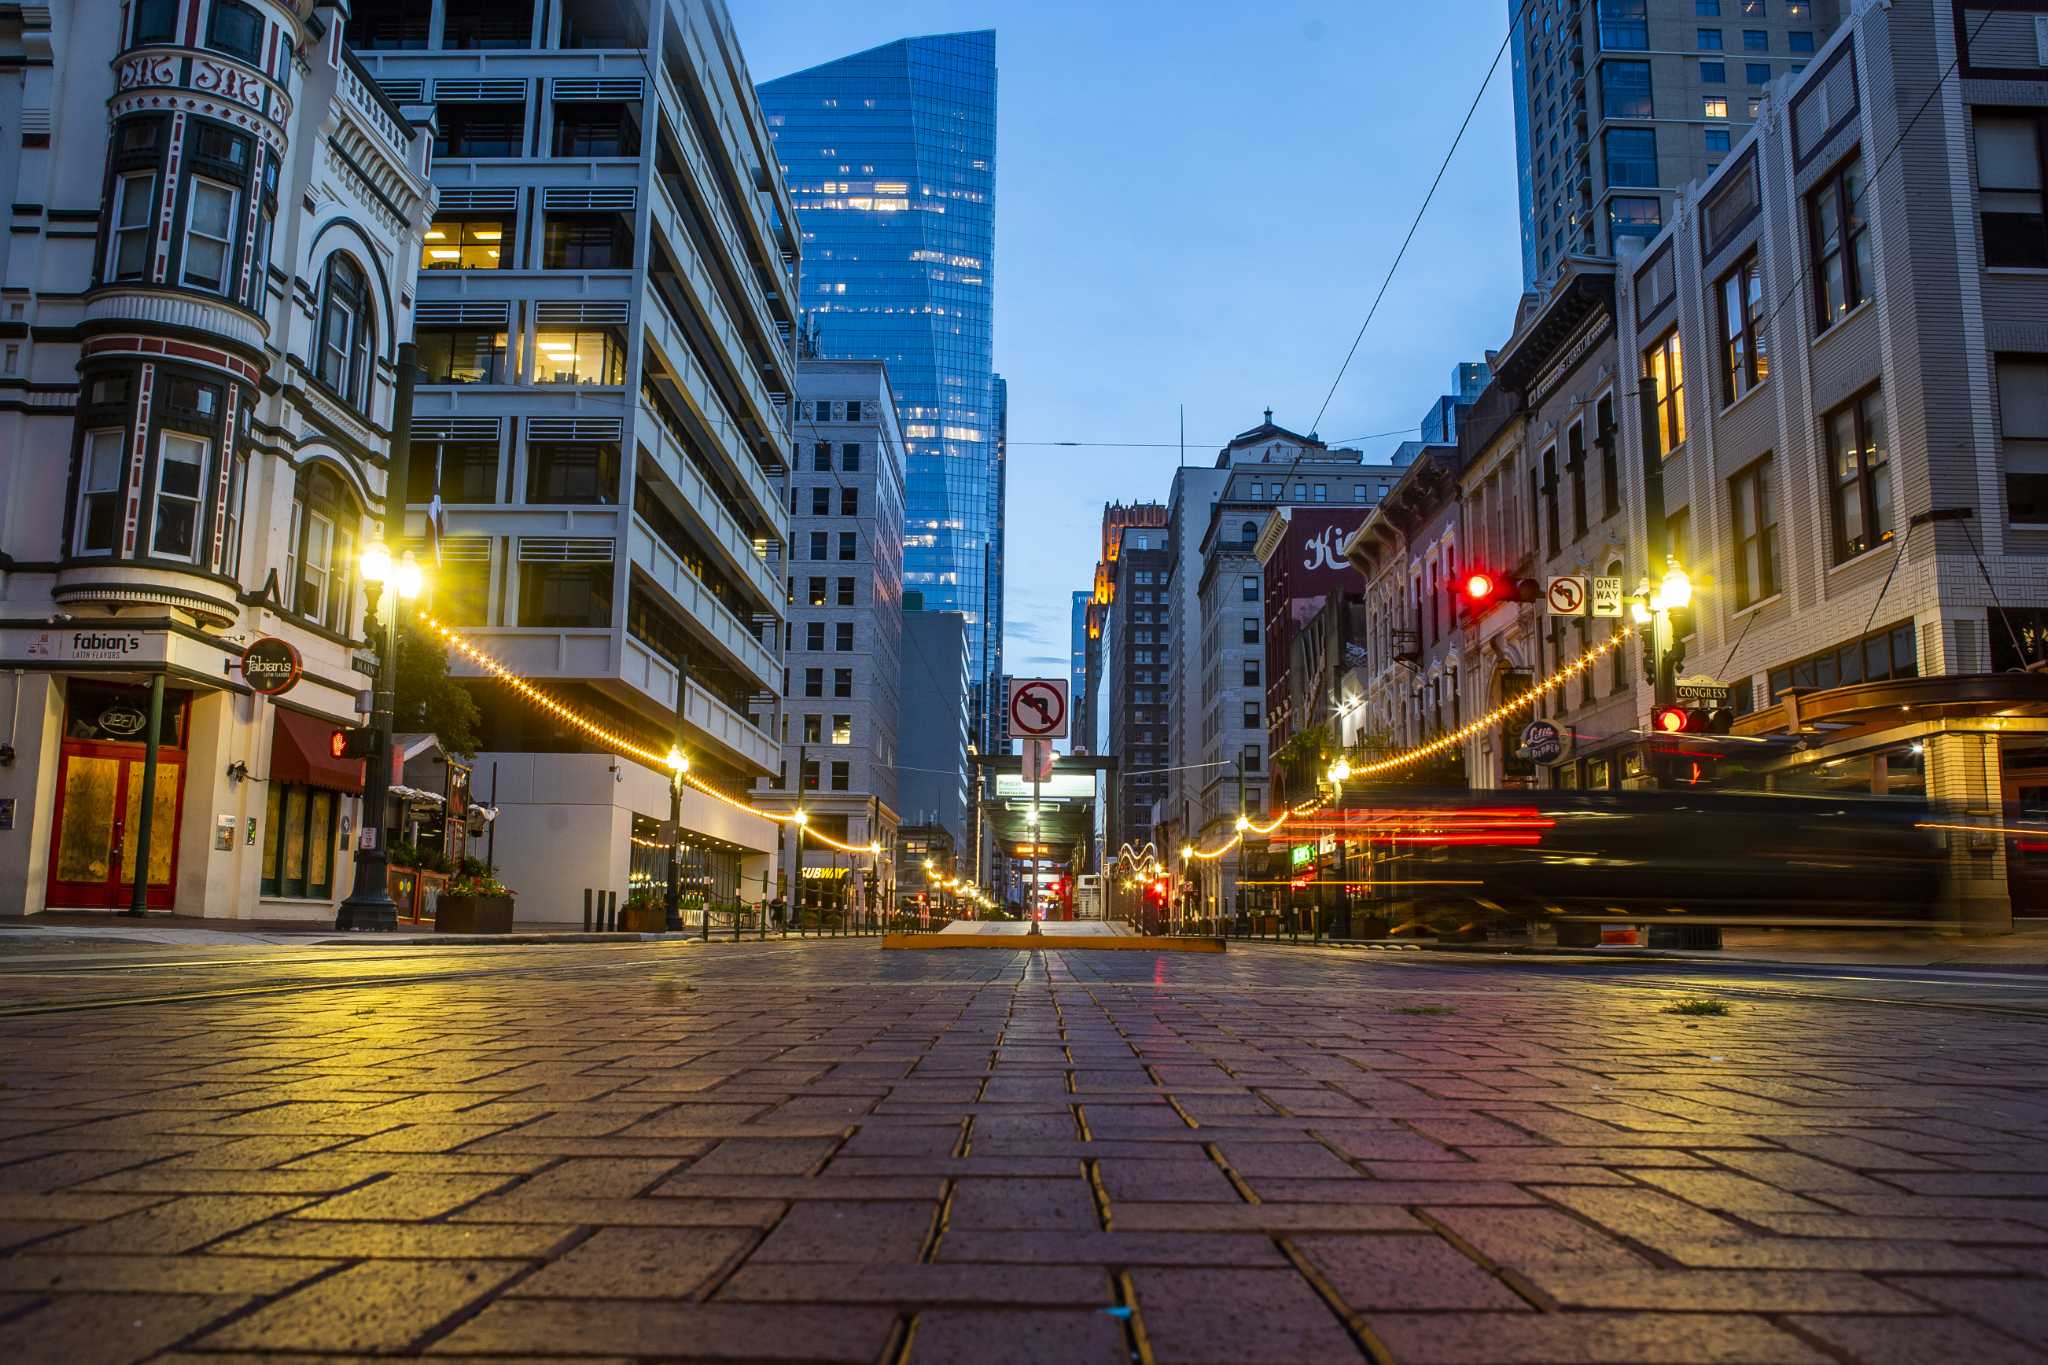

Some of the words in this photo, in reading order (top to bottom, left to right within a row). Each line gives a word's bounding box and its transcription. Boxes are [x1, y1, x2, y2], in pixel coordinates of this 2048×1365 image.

[1304, 525, 1360, 570] Ki
[1596, 579, 1618, 589] ONE
[1596, 590, 1618, 600] WAY
[73, 633, 139, 654] fabian's
[246, 655, 292, 675] fabian's
[1679, 686, 1727, 698] CONGRESS
[102, 713, 144, 729] OPEN
[801, 867, 849, 879] SUBWAY
